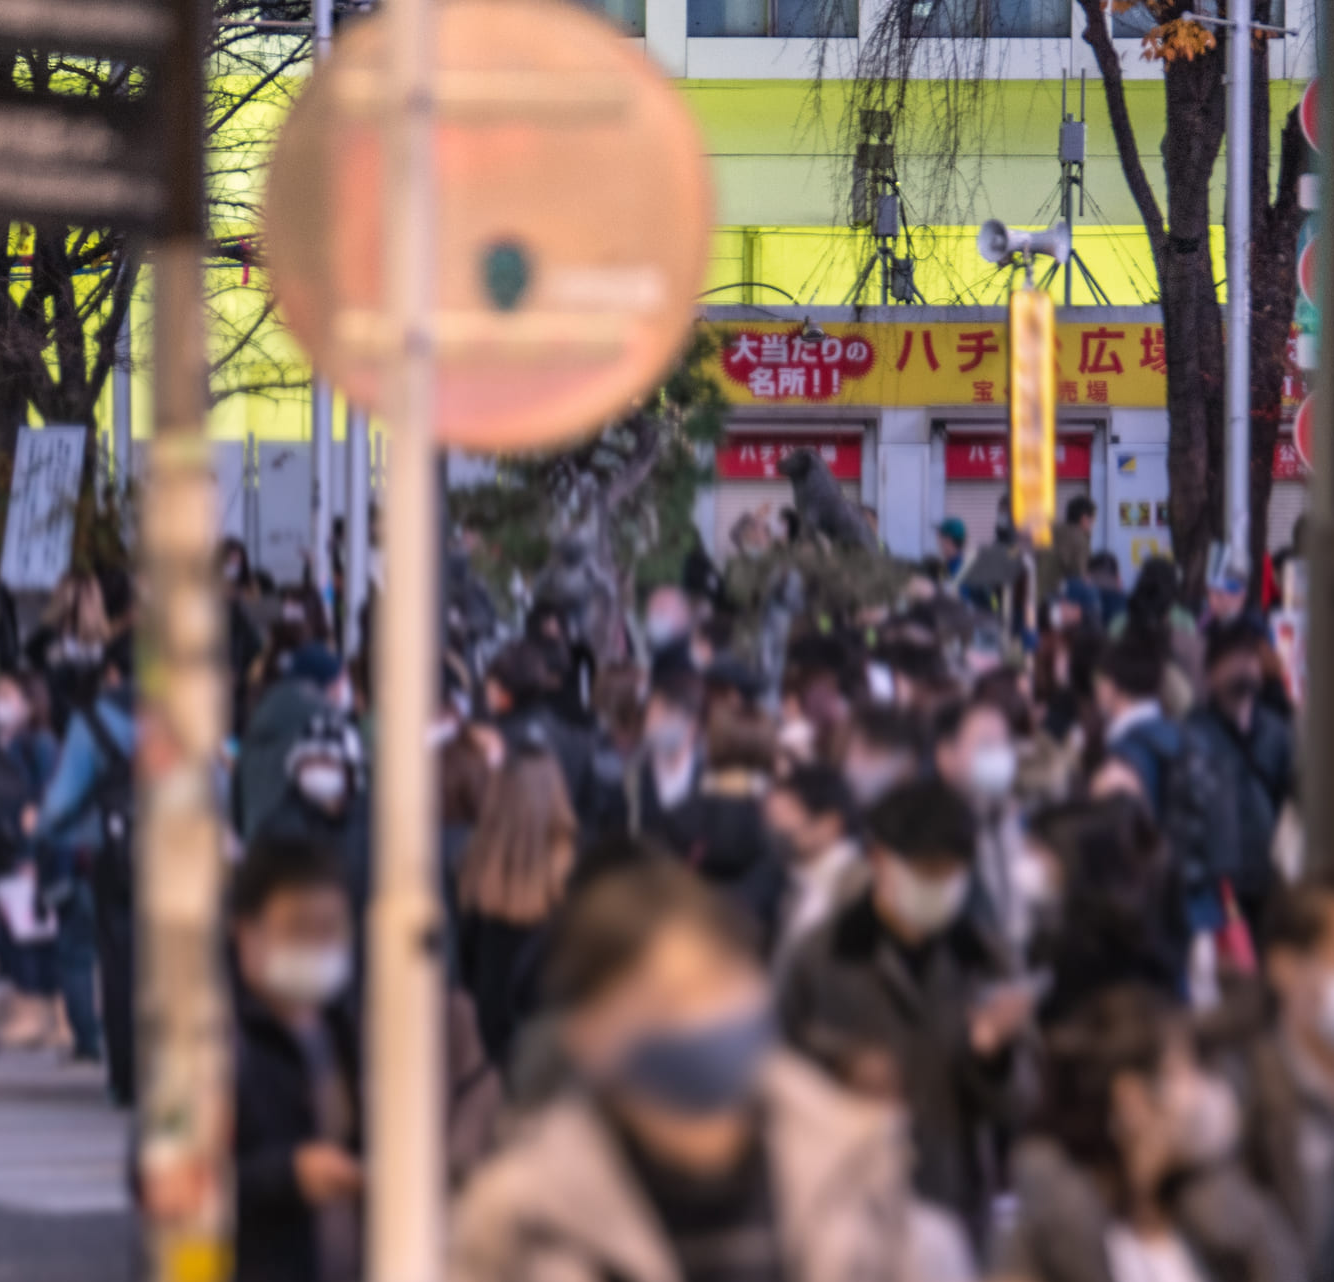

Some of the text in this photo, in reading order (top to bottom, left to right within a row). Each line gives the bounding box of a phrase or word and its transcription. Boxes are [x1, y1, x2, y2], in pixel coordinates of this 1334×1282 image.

[730, 334, 868, 364] 大当たりの
[895, 326, 1167, 375] ハチ広場
